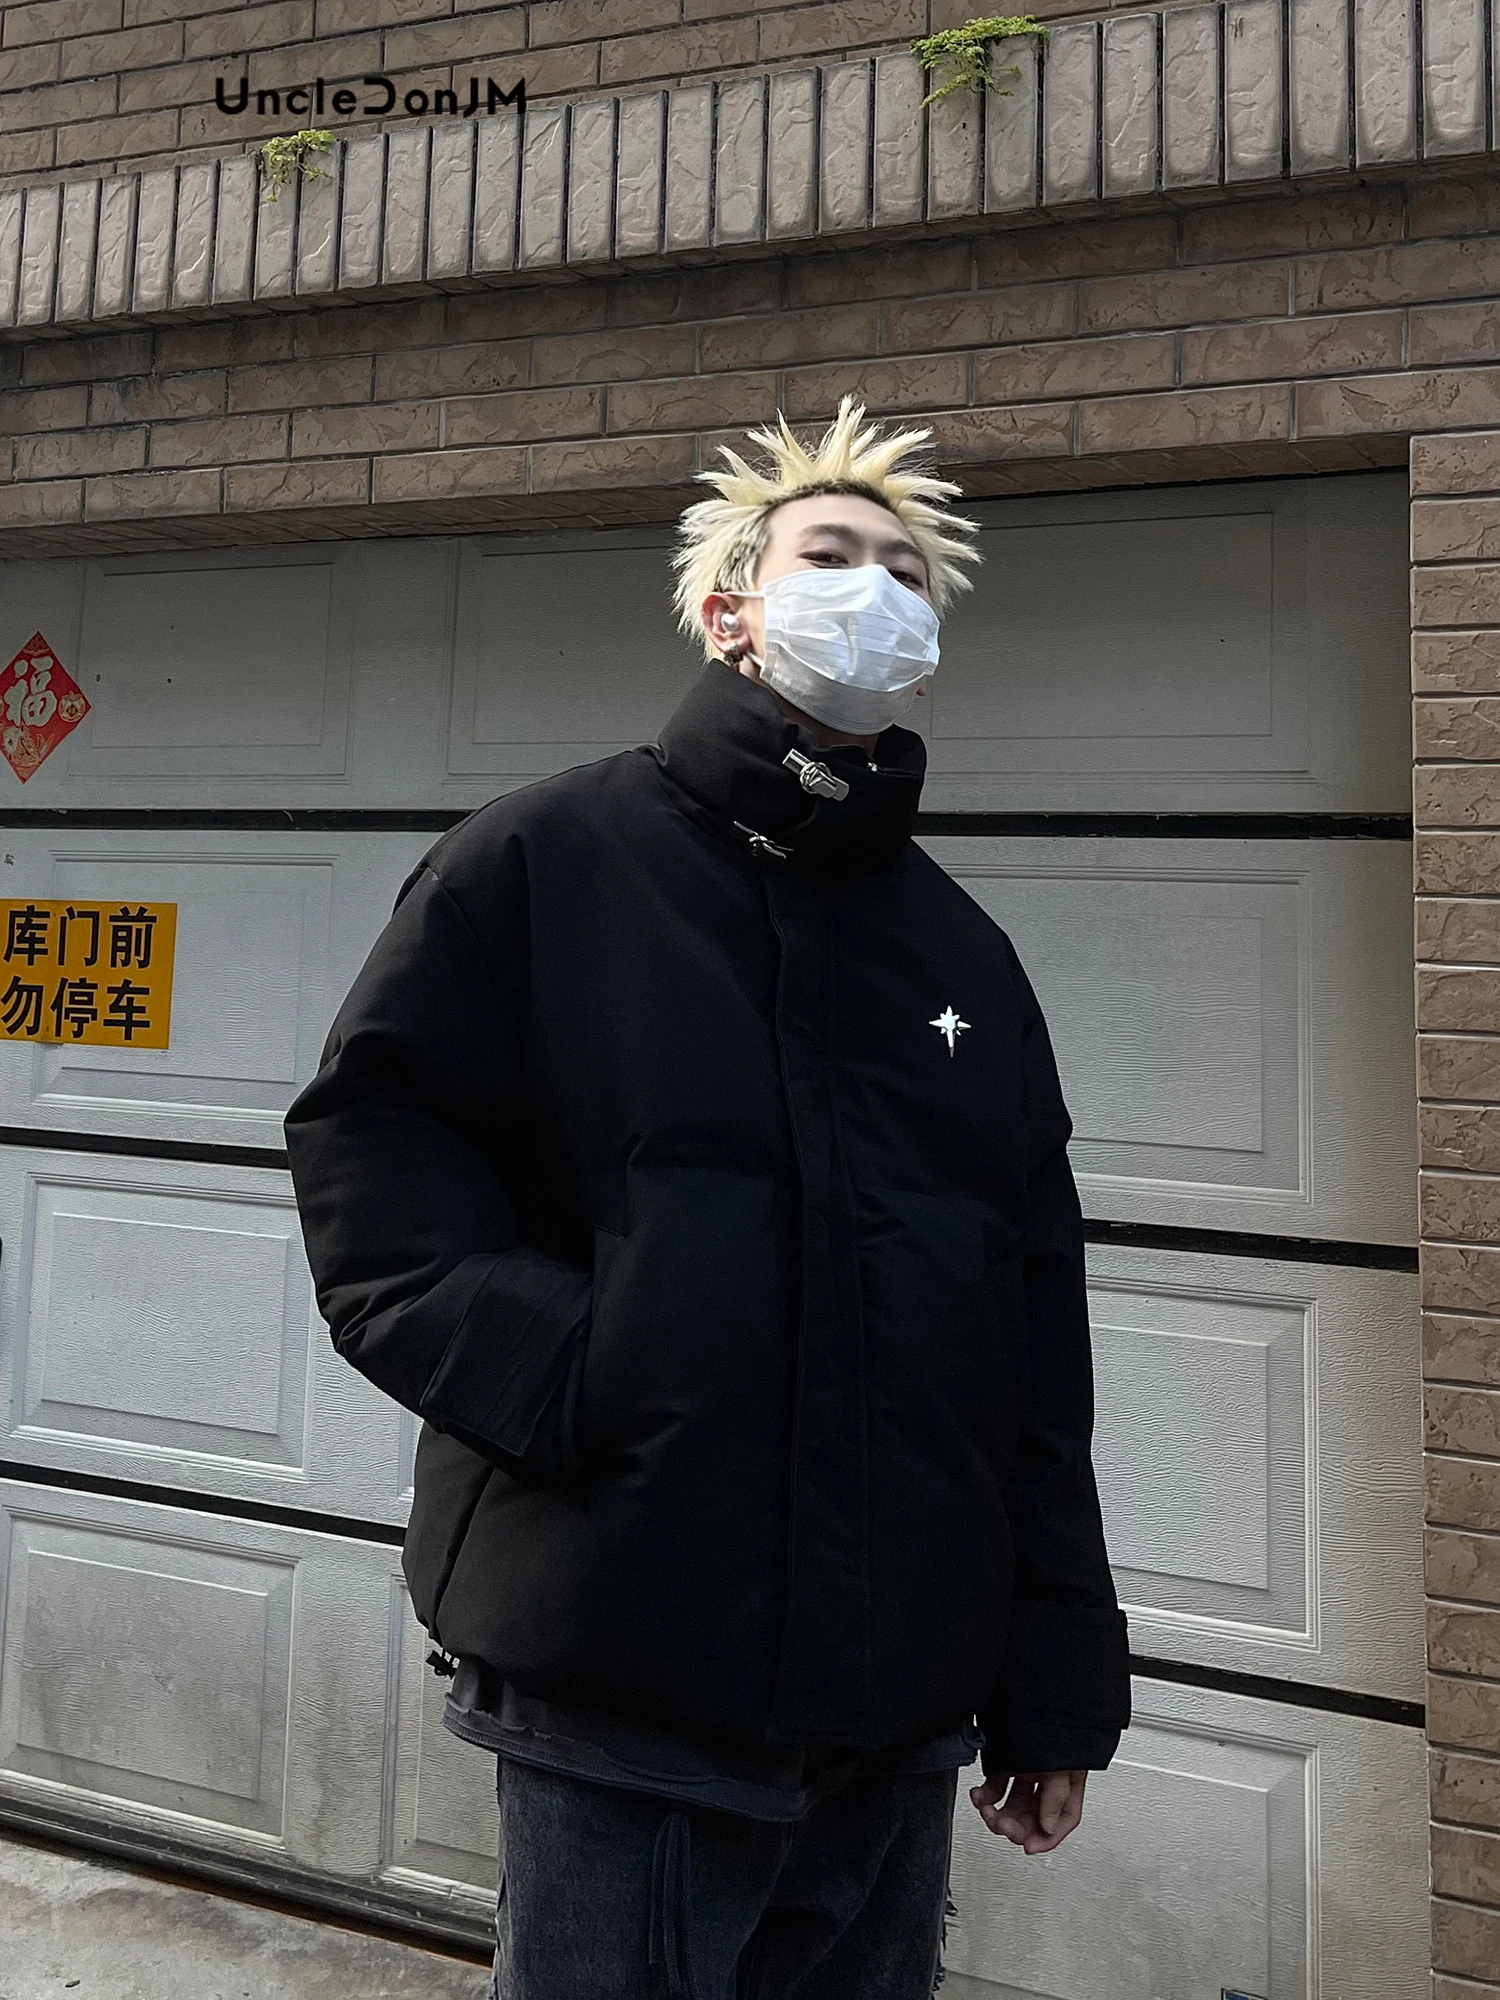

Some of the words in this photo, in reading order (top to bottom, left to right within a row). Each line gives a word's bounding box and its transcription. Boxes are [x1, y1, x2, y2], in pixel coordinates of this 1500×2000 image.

[4, 655, 57, 727] 福
[3, 905, 157, 968] 库门前
[0, 976, 151, 1041] 勿停车
